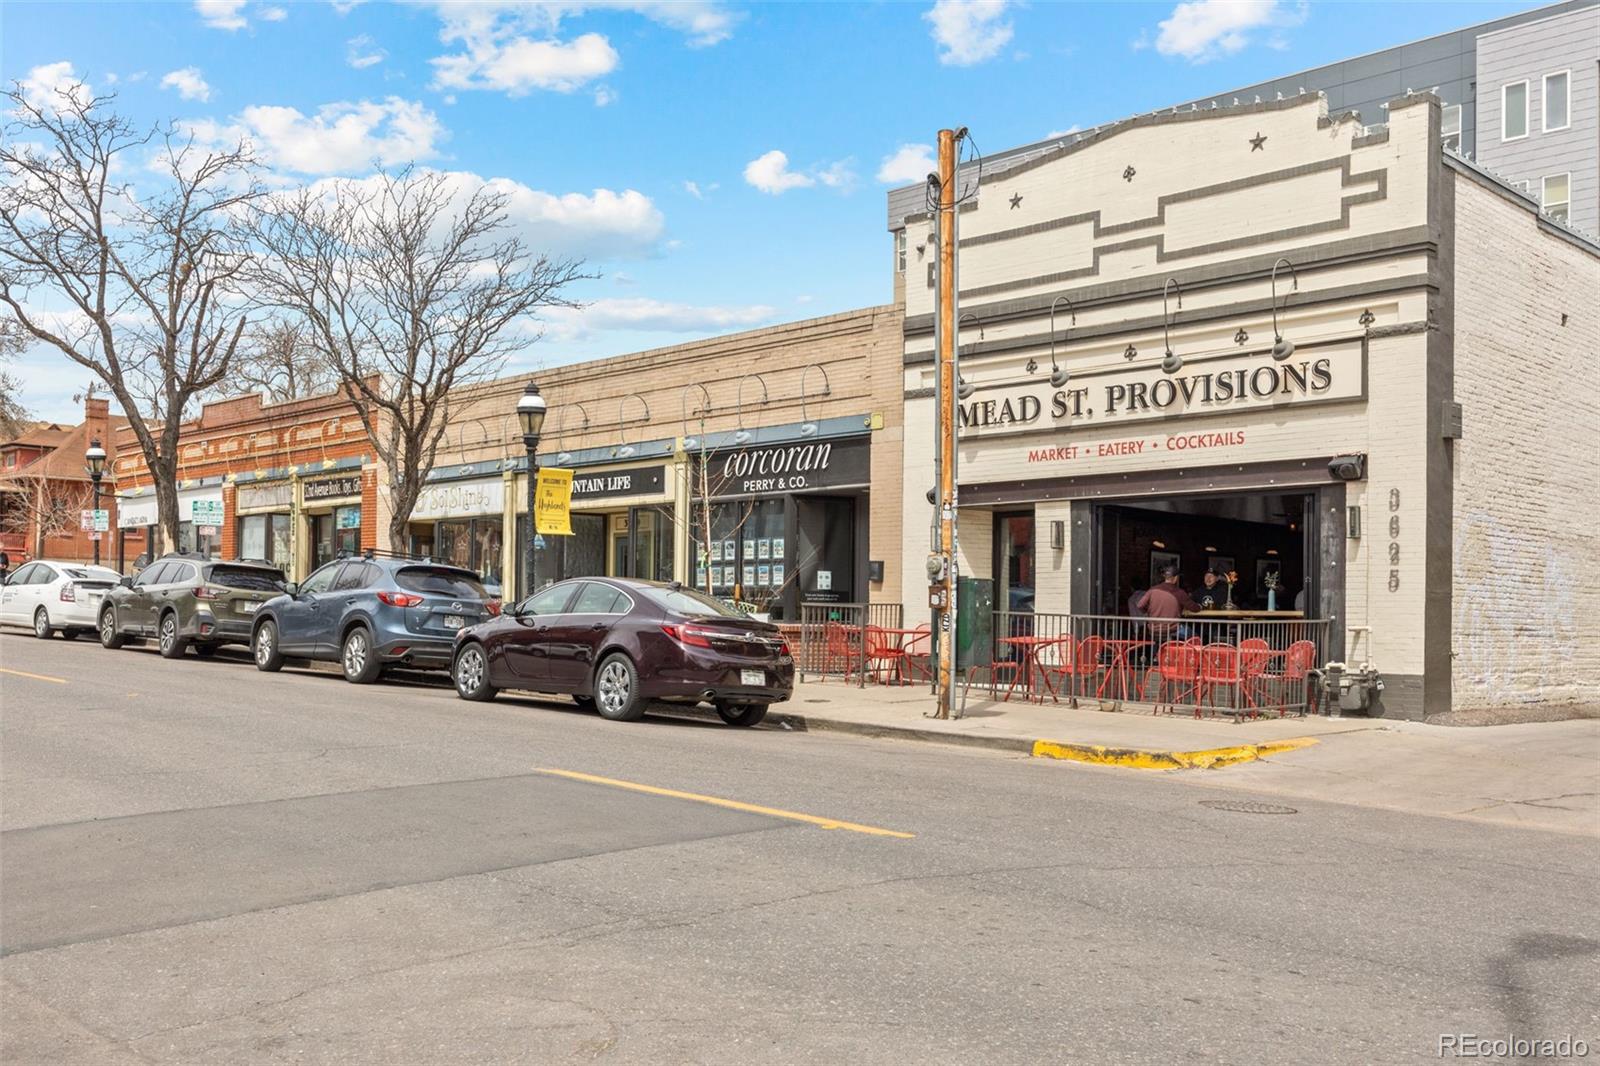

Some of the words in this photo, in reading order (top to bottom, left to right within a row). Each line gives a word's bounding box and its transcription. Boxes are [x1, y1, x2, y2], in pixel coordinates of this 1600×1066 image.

[958, 393, 1042, 429] MEAD
[1051, 386, 1094, 418] ST.
[1105, 357, 1333, 414] PROVISIONS
[1028, 446, 1079, 463] MARKET
[1098, 440, 1145, 457] EATERY
[1166, 430, 1245, 451] COCKTAILS
[723, 442, 832, 477] corcoran
[608, 475, 631, 491] LIFE
[743, 478, 774, 492] PERRY
[778, 477, 786, 489] &
[789, 476, 809, 488] CO.
[538, 497, 566, 512] Highlands
